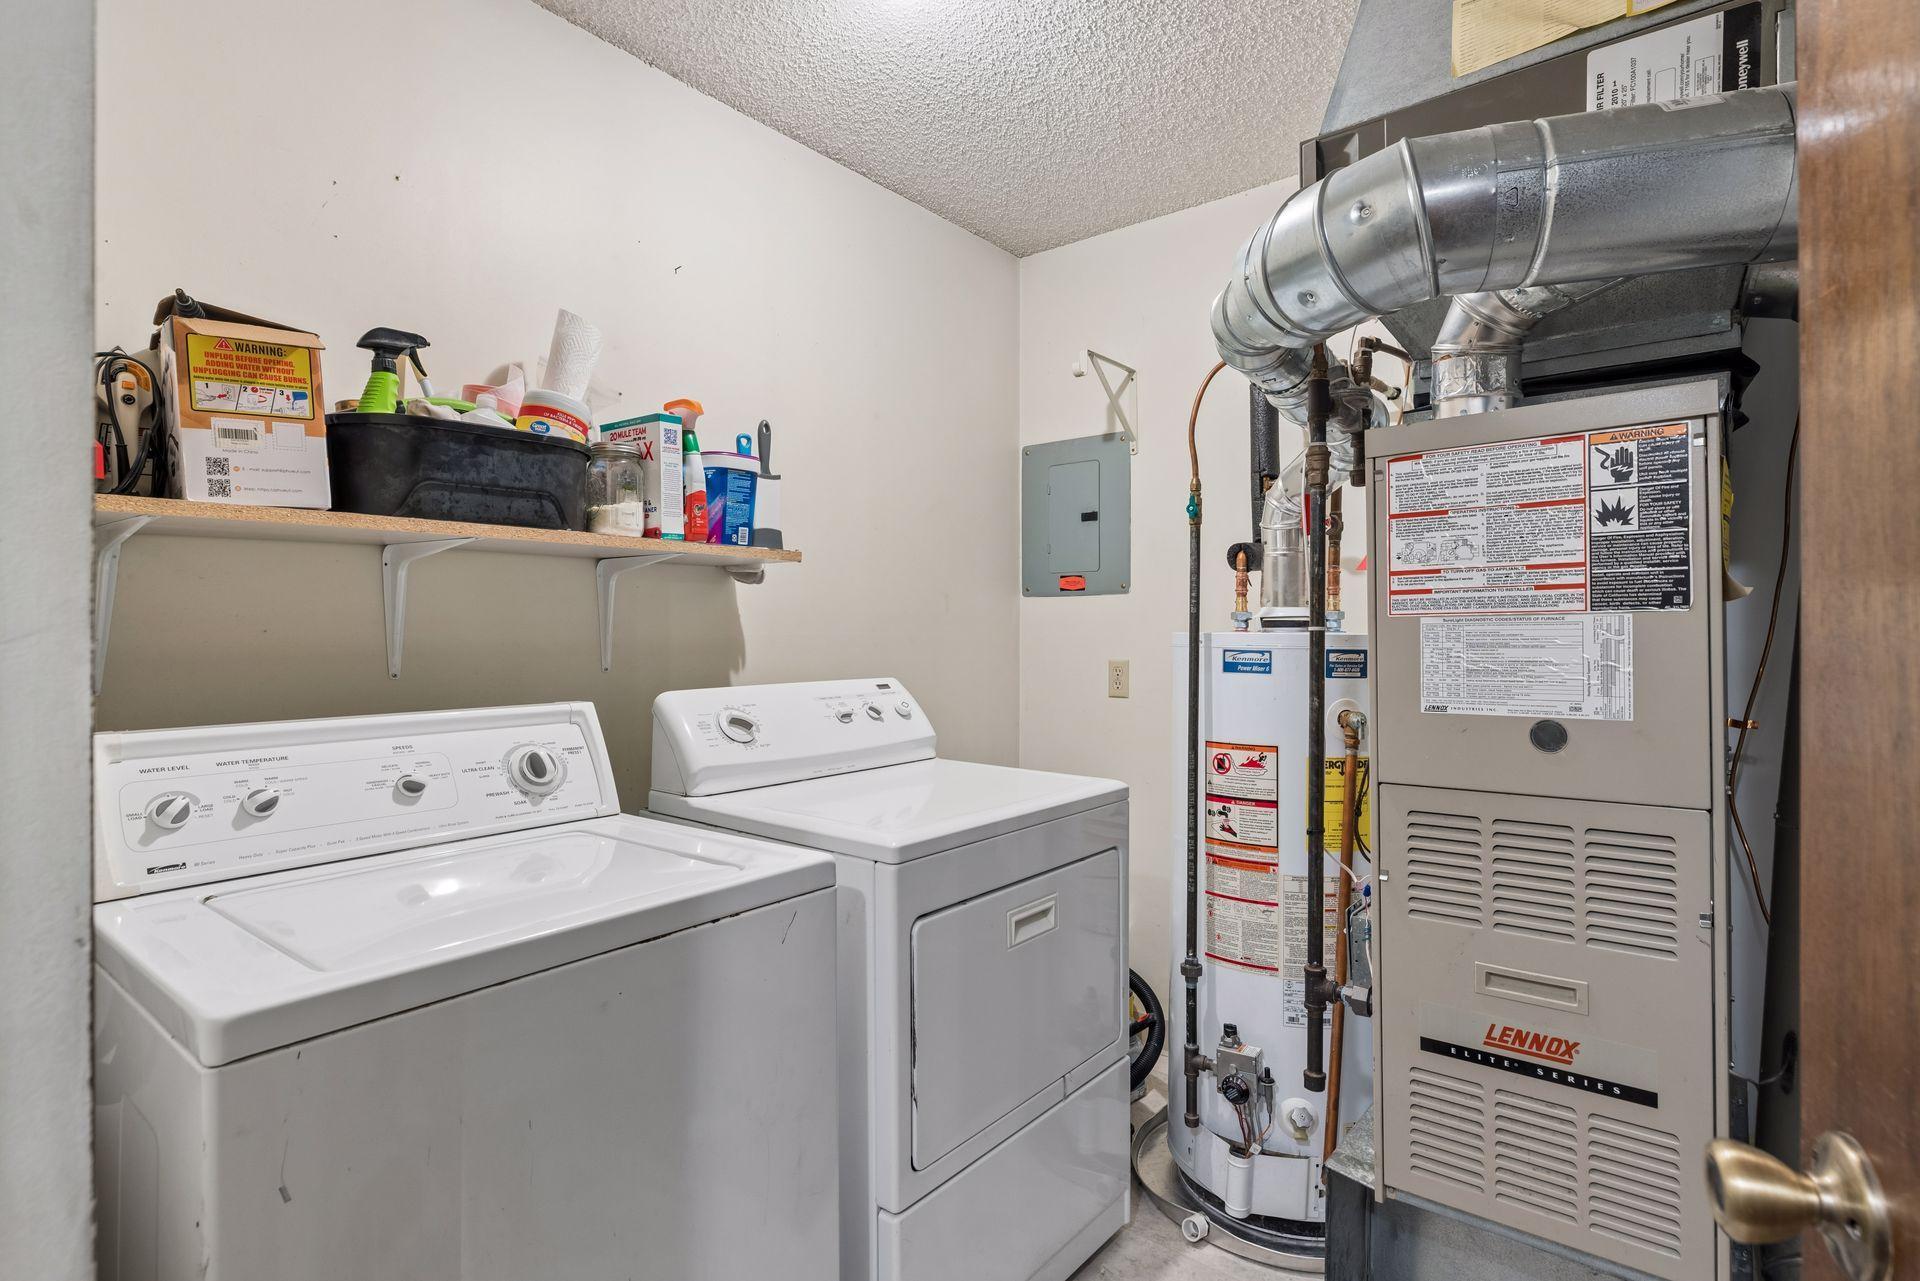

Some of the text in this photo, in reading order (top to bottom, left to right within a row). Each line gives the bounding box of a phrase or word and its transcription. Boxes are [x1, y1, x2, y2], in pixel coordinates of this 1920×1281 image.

[1736, 40, 1751, 90] oneywell
[1596, 72, 1604, 111] IR FILTER
[235, 342, 287, 357] WARNING:
[204, 351, 295, 368] UNPLUG BEFORE OPENING.
[206, 360, 294, 375] ADDING WATER WITHOUT
[193, 367, 309, 384] UNPLUGGING CAN CAUSE BURNS.
[610, 432, 617, 441] 20
[618, 429, 631, 439] MULE
[632, 427, 646, 437] TEAM
[1618, 428, 1664, 439] WARNING
[241, 756, 288, 764] TEMPERATURE
[154, 865, 186, 873] Kenmore
[1485, 1024, 1580, 1059] LENNOX
[1451, 1047, 1620, 1095] ELITE SERIES
